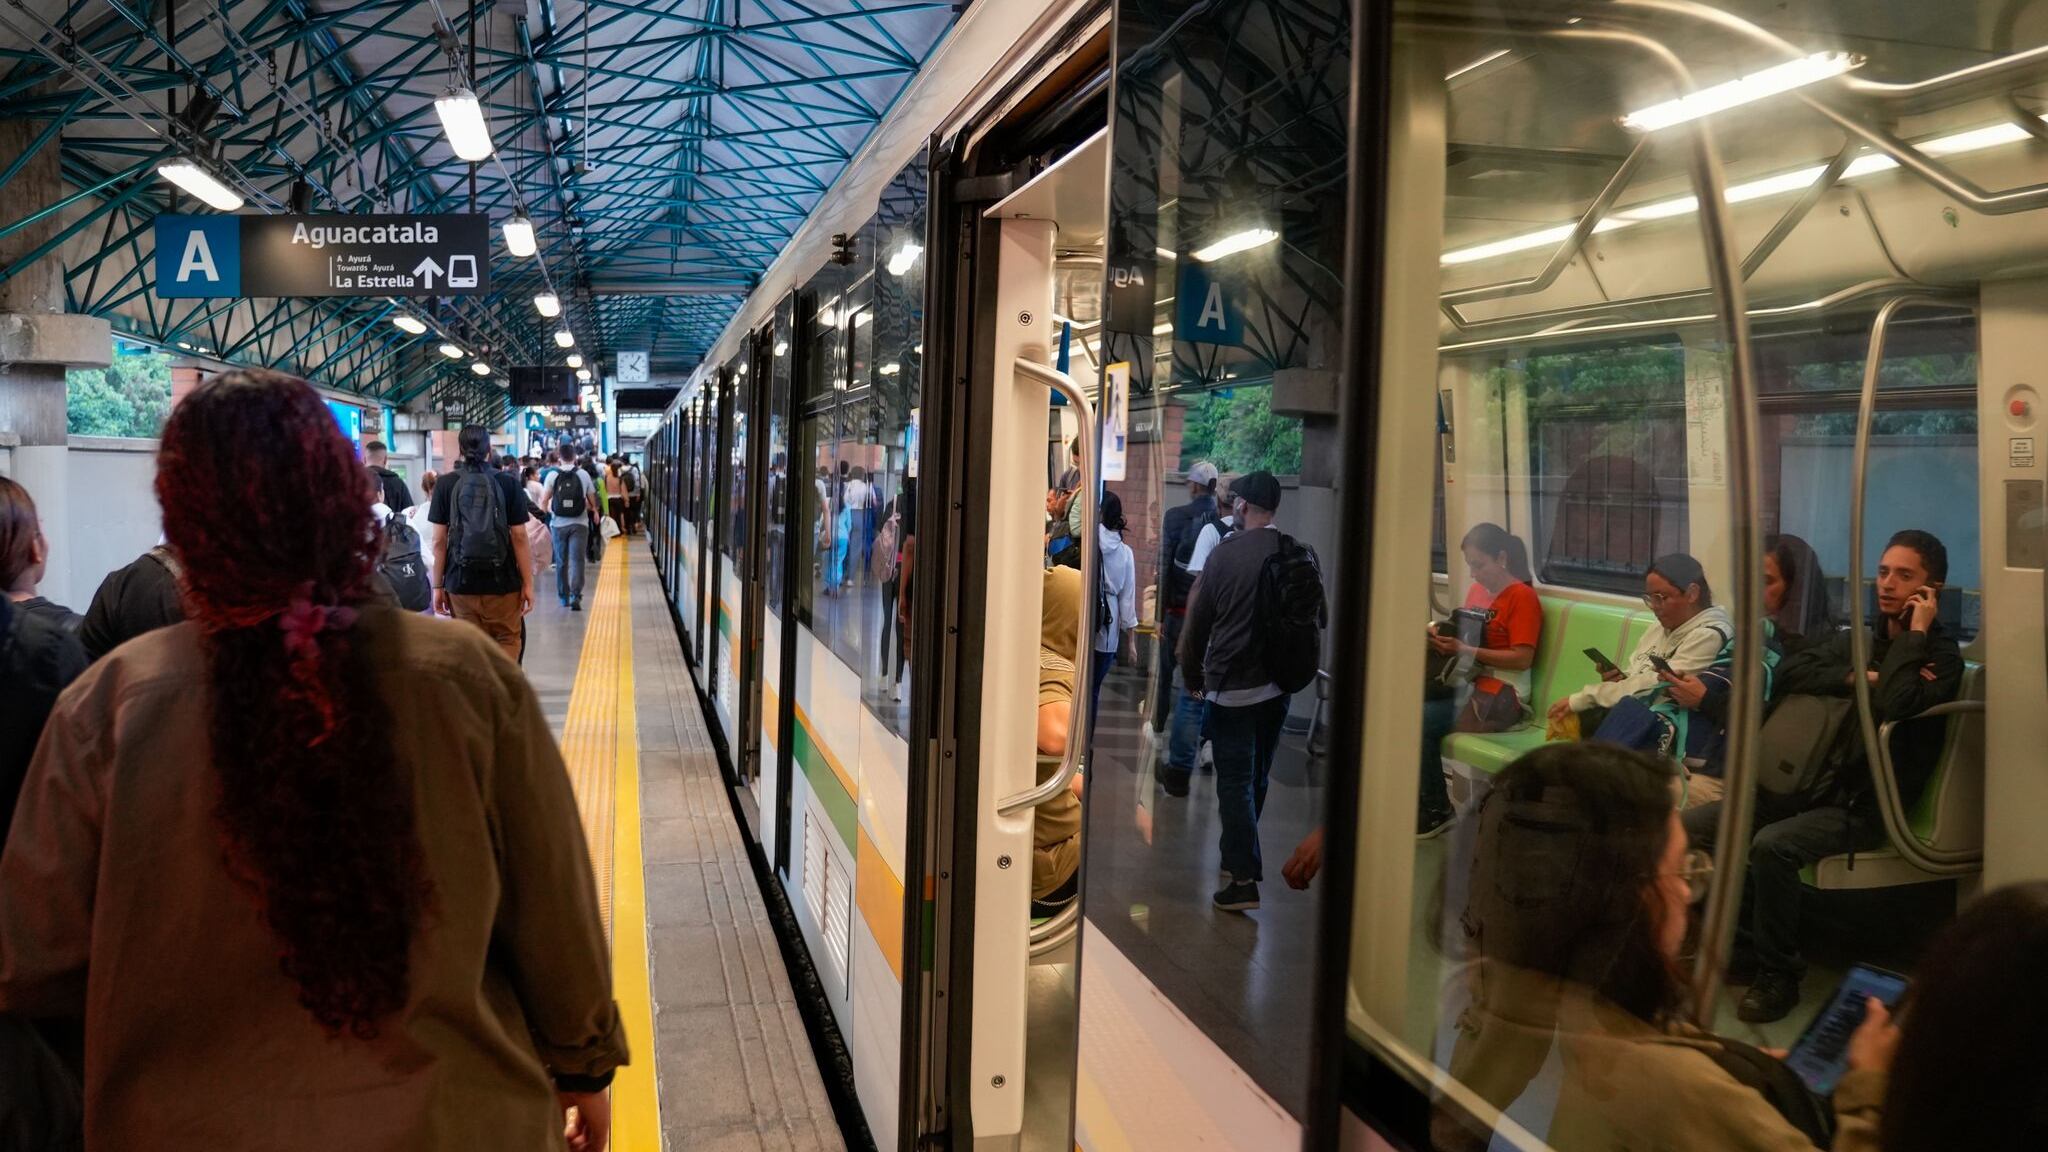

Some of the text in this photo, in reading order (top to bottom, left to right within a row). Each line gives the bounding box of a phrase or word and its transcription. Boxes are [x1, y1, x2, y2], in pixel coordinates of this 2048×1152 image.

[292, 222, 438, 248] Aguacatala
[176, 230, 220, 282] A
[348, 254, 372, 264] Ayurá
[373, 264, 395, 272] Ayurá
[336, 274, 414, 288] La Estrella
[529, 414, 541, 428] A
